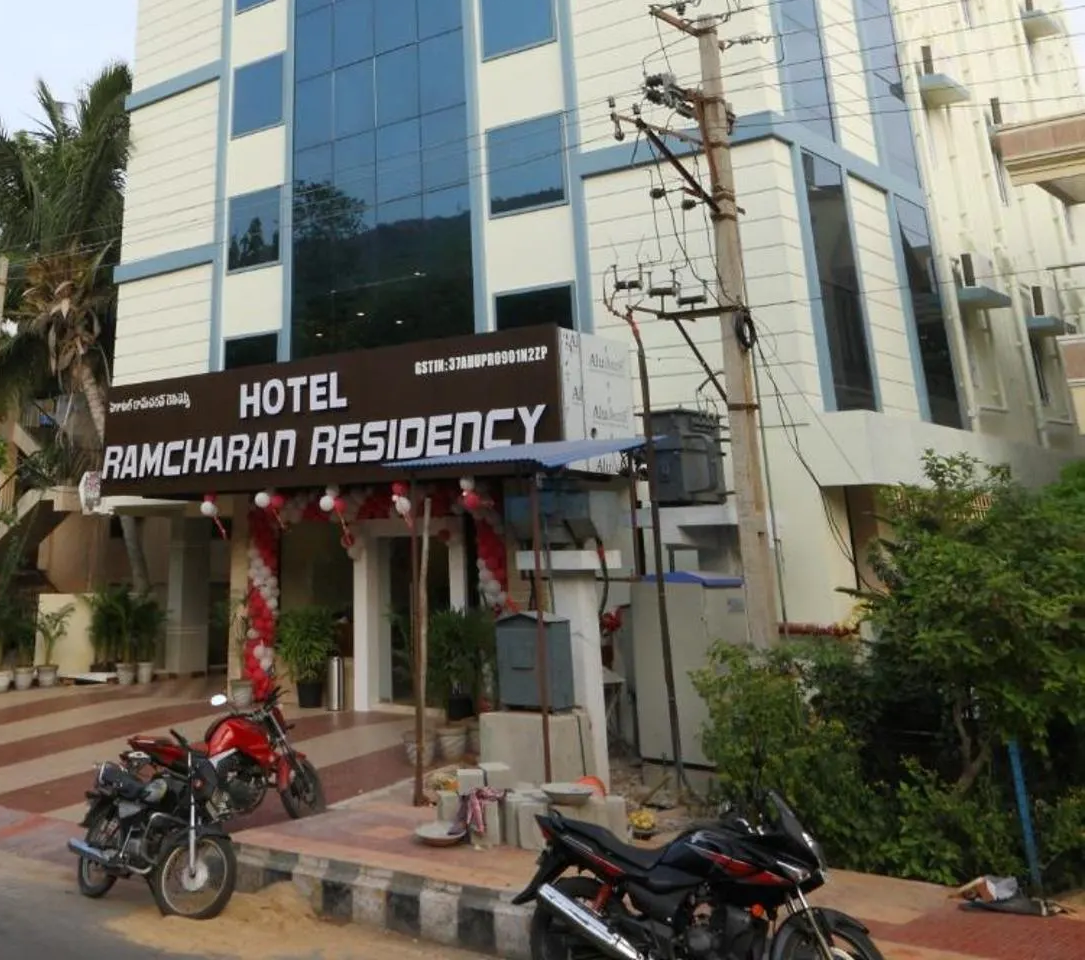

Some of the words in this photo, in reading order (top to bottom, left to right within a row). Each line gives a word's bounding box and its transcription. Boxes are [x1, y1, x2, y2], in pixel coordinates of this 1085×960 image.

[239, 371, 347, 419] HOTEL
[102, 429, 297, 480] RAMCHARAN
[309, 404, 546, 465] RESIDENCY
